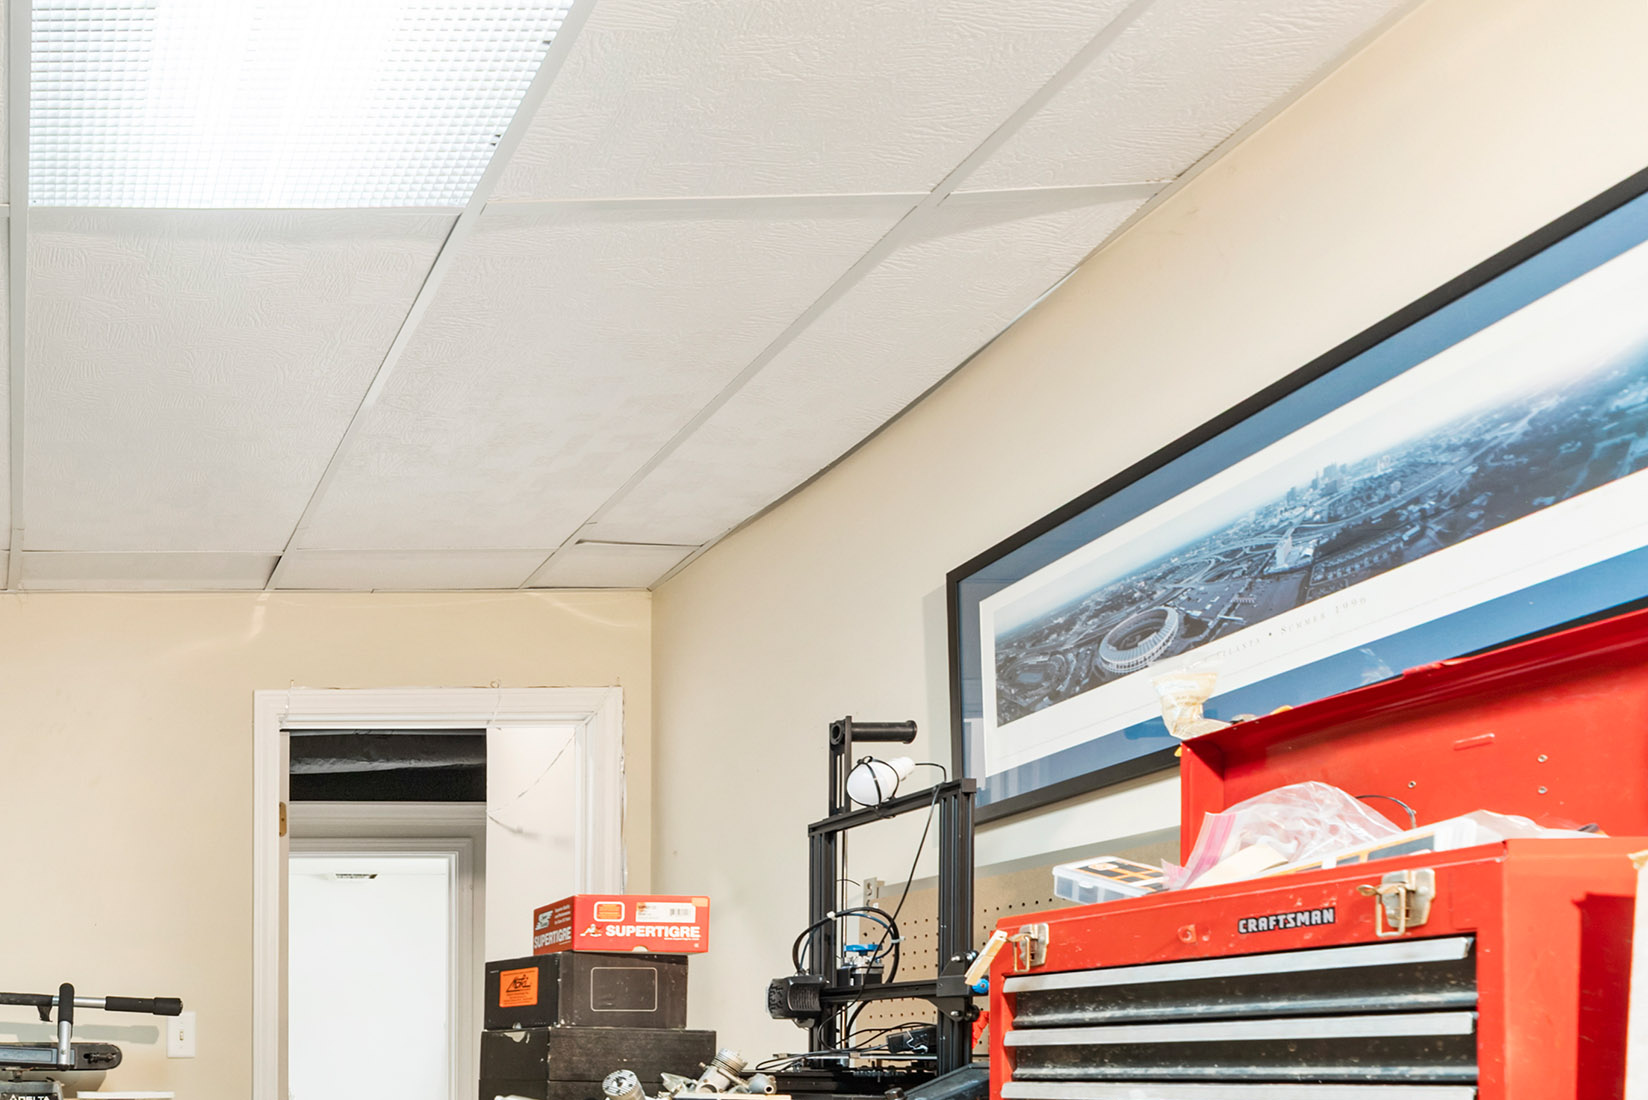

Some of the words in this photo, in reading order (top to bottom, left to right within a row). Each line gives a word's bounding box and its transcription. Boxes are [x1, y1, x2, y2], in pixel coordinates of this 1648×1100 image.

[605, 925, 702, 938] SUPERTIGRE
[1238, 907, 1335, 934] CRAFTSMAN
[534, 926, 572, 949] SUPERTIGRE
